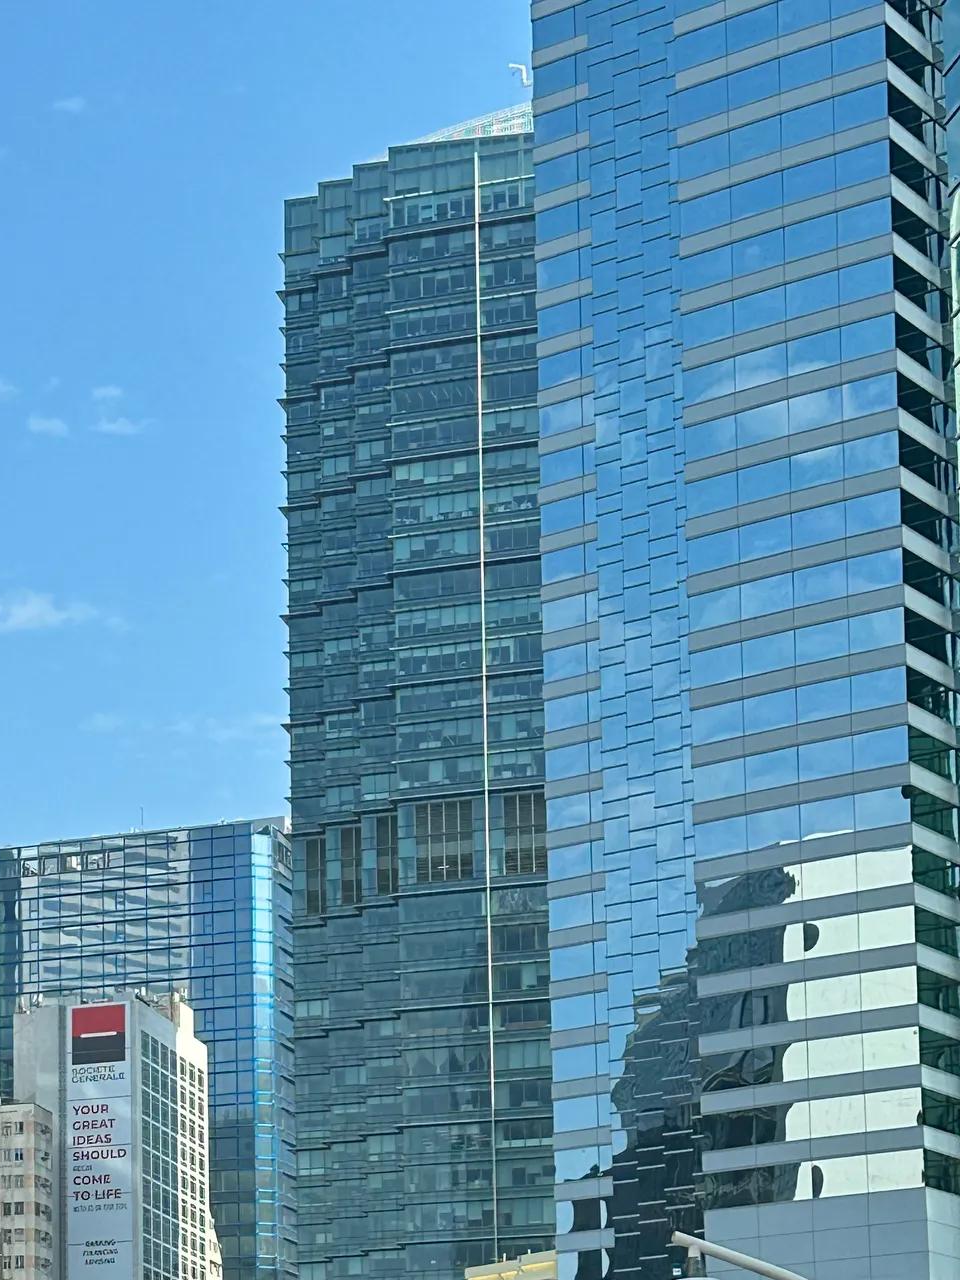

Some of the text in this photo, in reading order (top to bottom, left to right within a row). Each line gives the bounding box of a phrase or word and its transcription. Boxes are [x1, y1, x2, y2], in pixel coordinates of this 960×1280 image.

[72, 1104, 109, 1115] YOUR
[72, 1118, 116, 1130] GREAT
[72, 1134, 112, 1146] IDEAS
[72, 1149, 127, 1161] SHOULD
[73, 1174, 111, 1185] COME
[73, 1189, 122, 1201] TO LIFE
